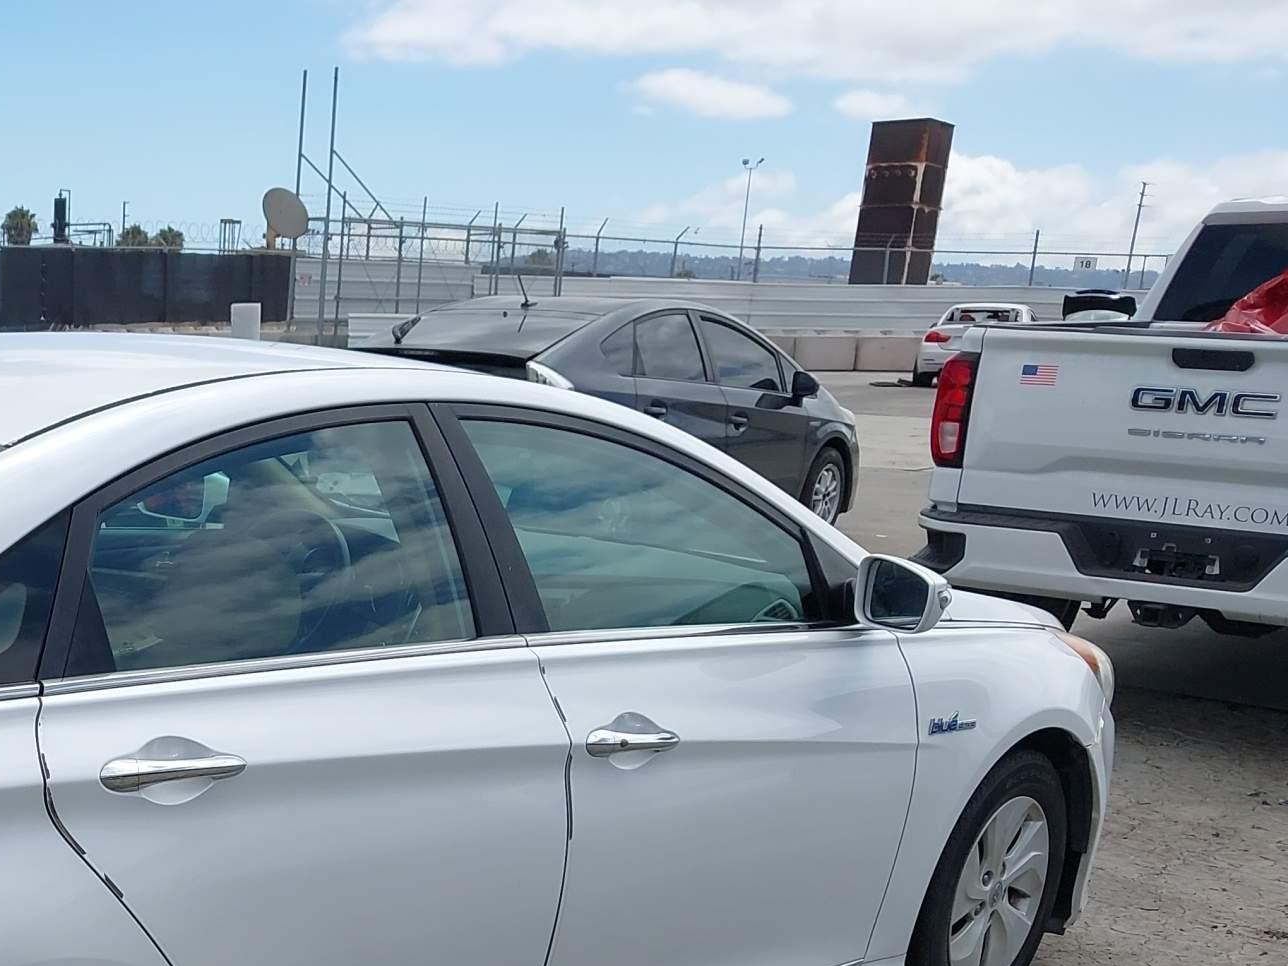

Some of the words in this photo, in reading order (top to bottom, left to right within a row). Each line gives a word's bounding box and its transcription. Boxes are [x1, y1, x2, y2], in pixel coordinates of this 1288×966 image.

[1080, 260, 1092, 269] 18
[1130, 386, 1280, 420] GMC
[1128, 428, 1265, 444] SIERRA
[1092, 492, 1288, 527] WWW.JLRAY.COM
